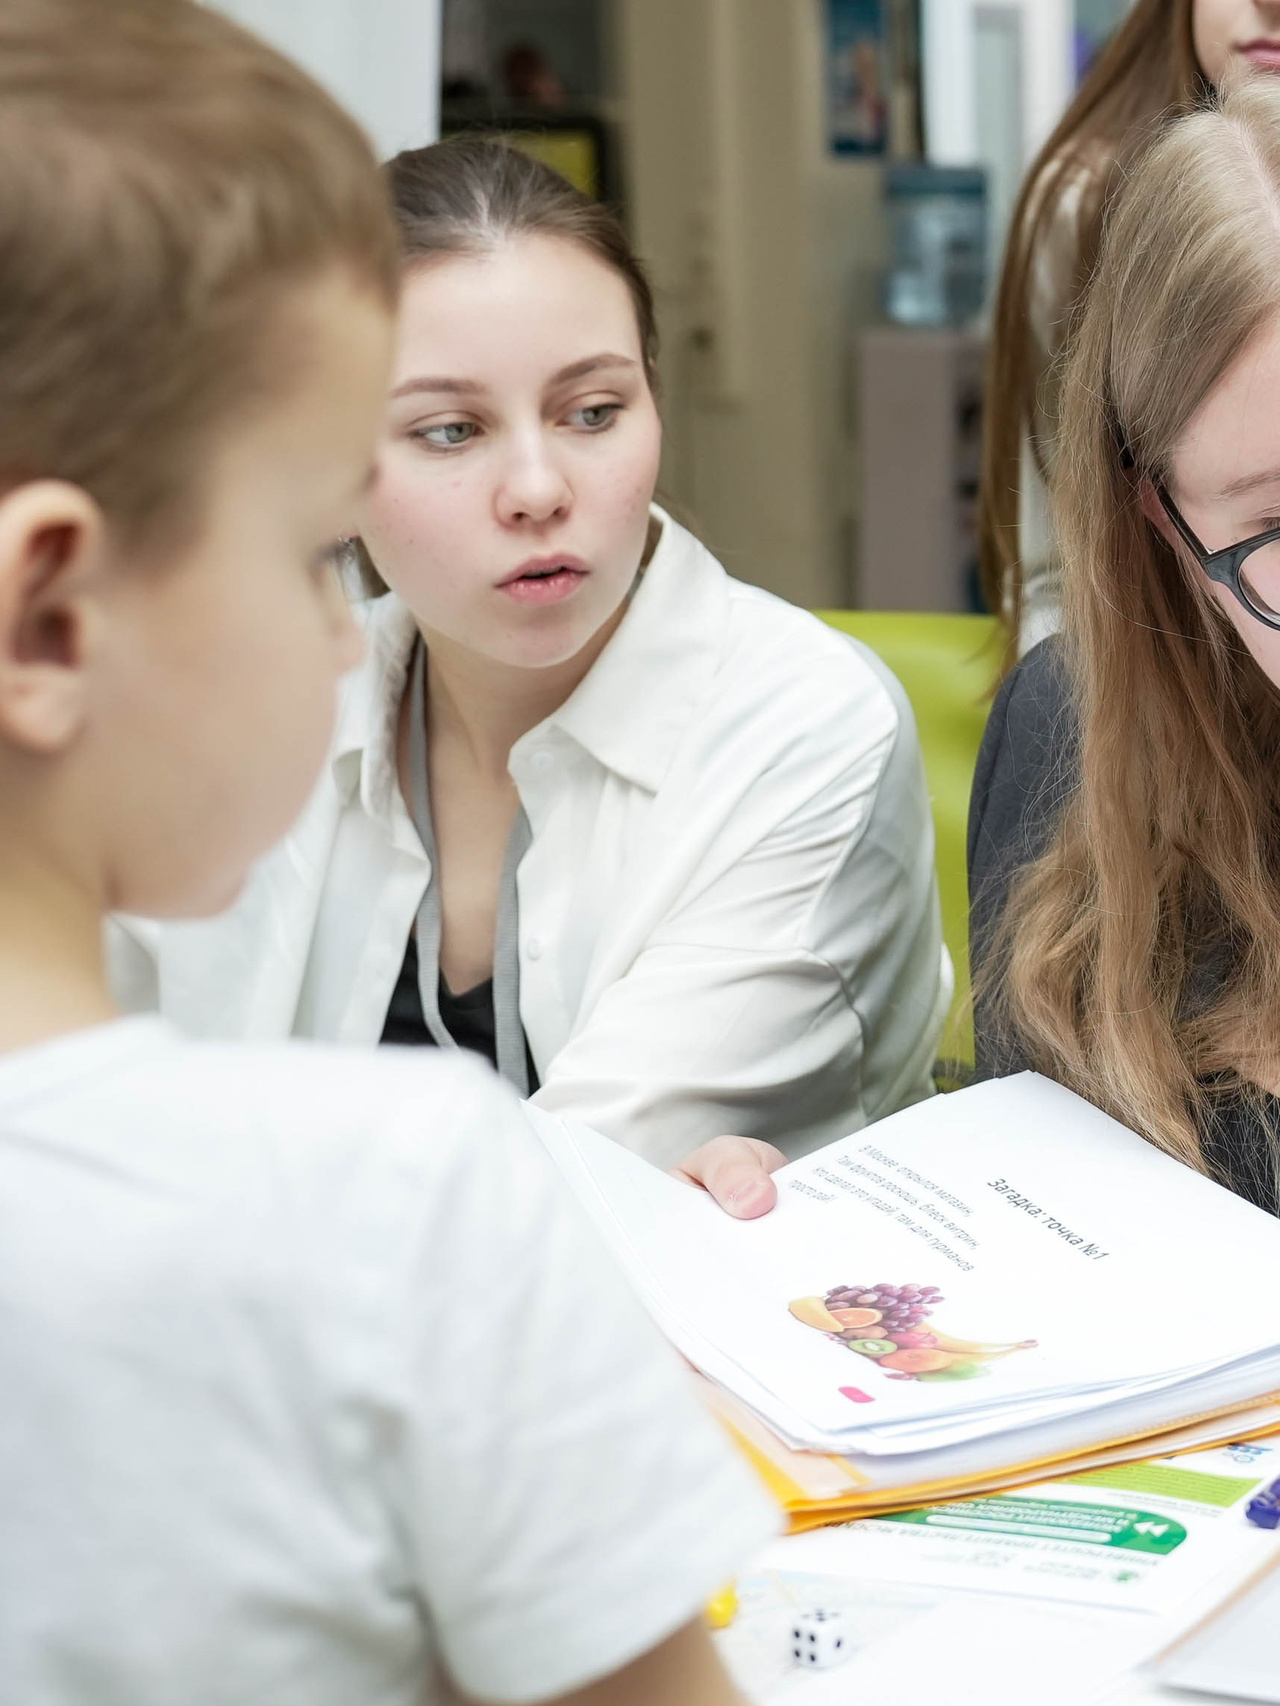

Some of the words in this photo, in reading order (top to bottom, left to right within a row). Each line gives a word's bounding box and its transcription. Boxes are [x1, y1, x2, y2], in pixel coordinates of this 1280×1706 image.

[824, 1173, 853, 1190] сделал
[849, 1187, 870, 1200] это
[894, 1212, 916, 1231] там
[908, 1223, 933, 1240] для
[927, 1237, 975, 1272] гурманов
[835, 1155, 852, 1169] Там
[849, 1162, 888, 1186] фруктов
[918, 1203, 950, 1224] блеск
[943, 1222, 981, 1251] витрин,
[867, 1147, 900, 1168] Москве
[896, 1166, 940, 1192] открылся
[934, 1188, 975, 1217] магазин,
[987, 1178, 1047, 1218] Загадка:
[1041, 1217, 1084, 1246] точка
[1078, 1242, 1110, 1260] №1
